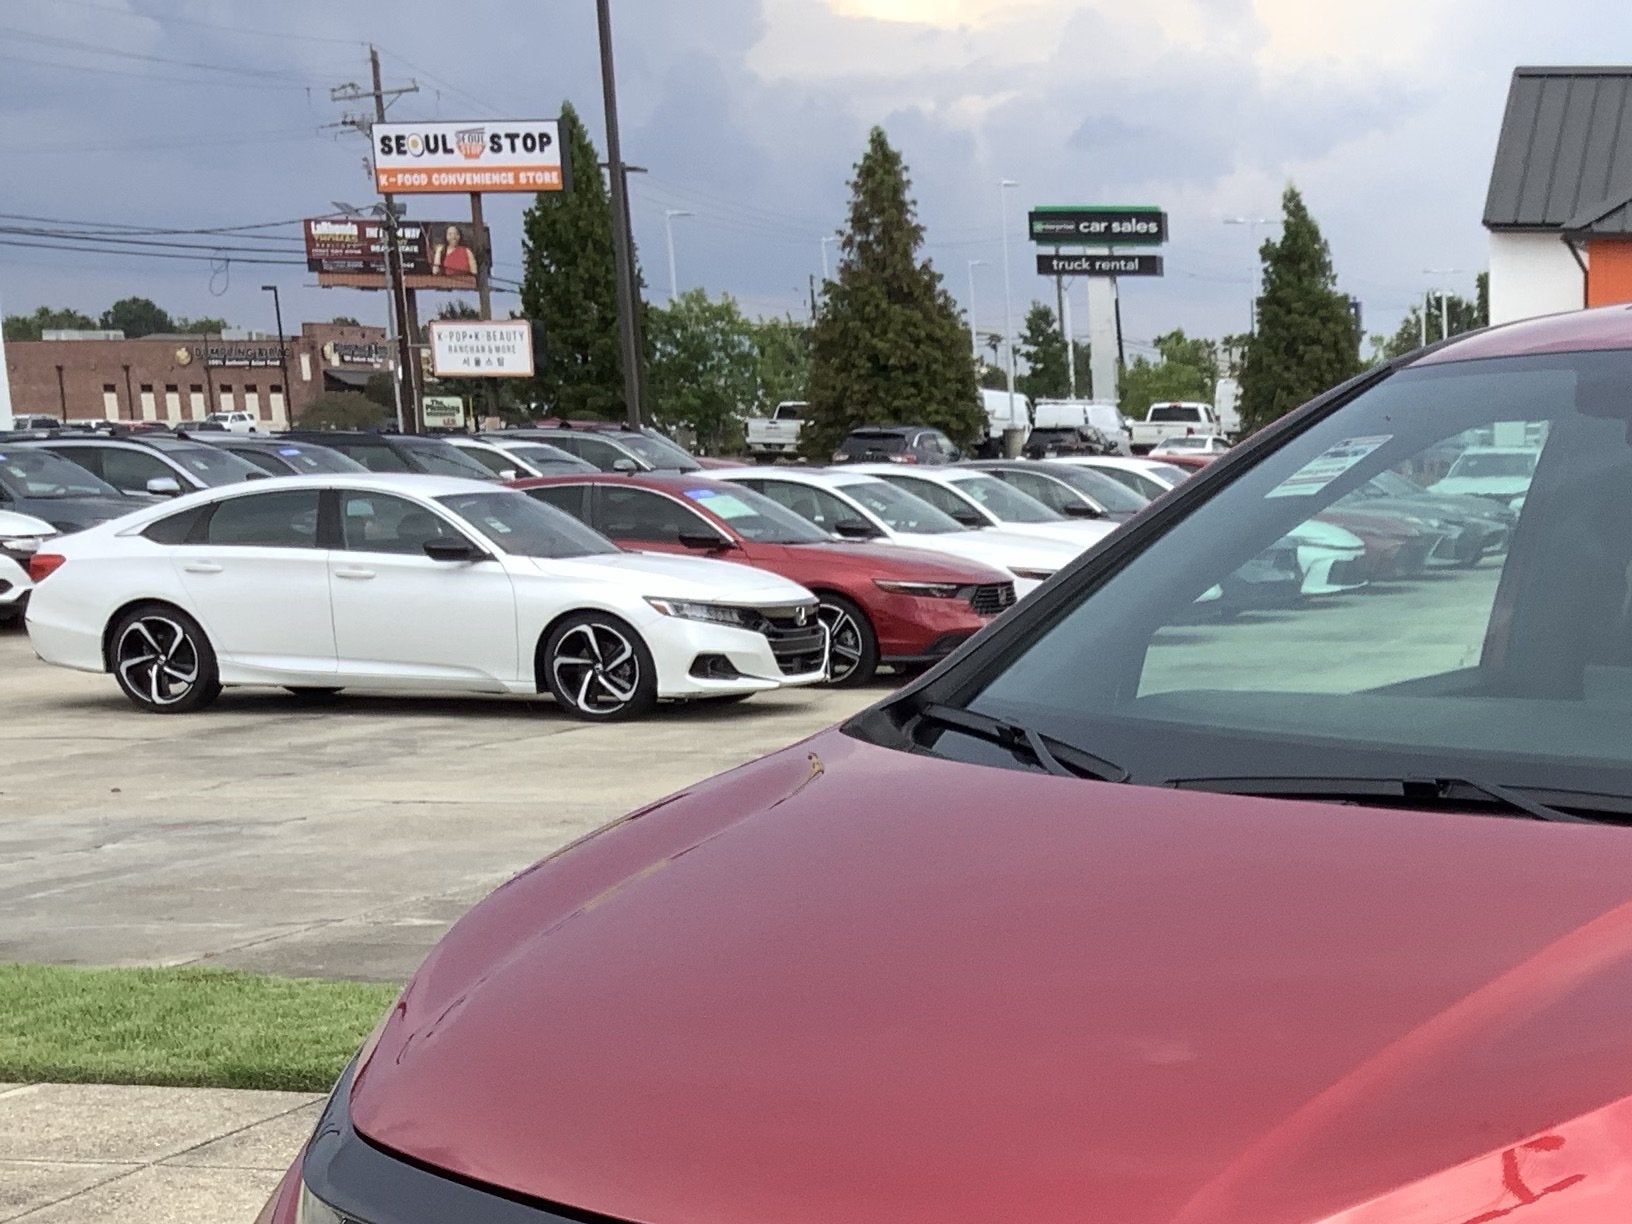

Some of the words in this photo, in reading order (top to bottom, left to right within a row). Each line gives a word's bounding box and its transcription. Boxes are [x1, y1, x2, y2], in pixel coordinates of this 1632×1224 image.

[381, 133, 454, 157] SEOUL
[489, 132, 552, 154] STOP
[380, 171, 428, 187] K-FOOD
[432, 171, 514, 187] CONVENIENCE
[519, 170, 559, 186] STORE
[1079, 221, 1107, 233] car
[1111, 218, 1158, 233] sales
[1052, 258, 1090, 270] truck
[1095, 258, 1139, 271] rental
